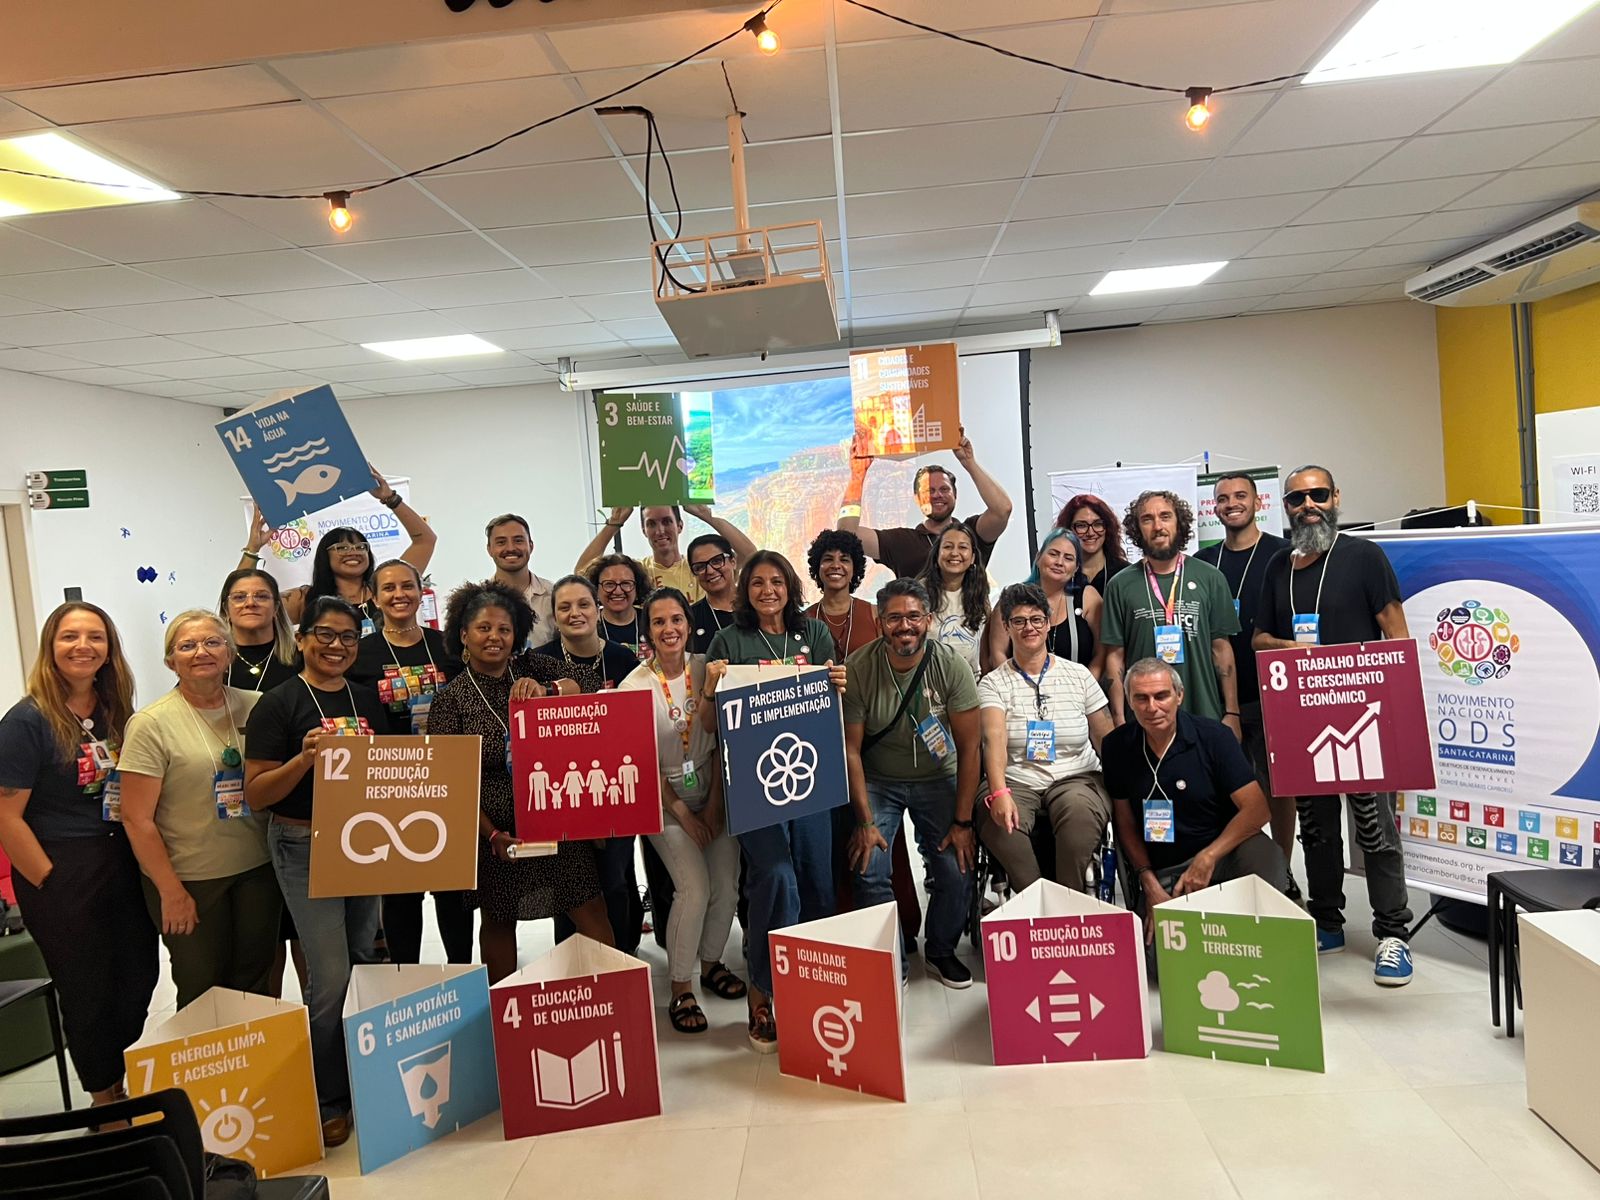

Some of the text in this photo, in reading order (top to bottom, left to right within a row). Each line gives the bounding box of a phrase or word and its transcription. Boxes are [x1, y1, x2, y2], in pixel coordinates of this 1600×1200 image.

[910, 354, 914, 363] E
[605, 402, 619, 427] 3
[626, 400, 660, 412] SAÚDE E
[255, 410, 290, 429] VIDA NA
[627, 416, 673, 426] BEM-ESTAR
[224, 426, 252, 453] 14
[263, 427, 287, 443] ÁGUA
[1570, 465, 1596, 475] WI-FI
[317, 513, 398, 530] MOVIMENTO ODS
[1295, 651, 1406, 672] TRABALHO DECENTE
[1269, 661, 1288, 691] 8
[1298, 671, 1385, 689] E CRESCIMENTO
[749, 680, 829, 708] PARCERIAS E MEIOS
[1300, 689, 1366, 707] ECONÔMICO
[1437, 694, 1515, 709] MOVIMENTO
[537, 702, 608, 720] ERRADICAÇÃO
[722, 698, 743, 731] 17
[751, 695, 831, 725] DE IMPLEMENTAÇÃO
[1438, 706, 1515, 721] NACIONAL
[514, 710, 526, 739] 1
[538, 722, 600, 738] DA POBREZA
[1438, 718, 1516, 747] ODS
[320, 748, 351, 780] 12
[368, 748, 433, 761] CONSUMO E
[1439, 747, 1515, 762] SANTA CATARINA
[367, 763, 429, 783] PRODUÇÃO
[366, 781, 448, 799] RESPONSÁVEIS
[1404, 863, 1487, 885] neariocamboriu@sc.m
[1030, 925, 1103, 943] REDUÇÃO DAS
[1158, 920, 1187, 951] 15
[1201, 923, 1227, 937] VIDA
[988, 931, 1017, 962] 10
[1032, 943, 1115, 959] DESIGUALDADES
[1202, 941, 1262, 958] TERRESTRE
[775, 944, 790, 975] 5
[797, 948, 847, 969] IGUALDADE
[799, 966, 847, 986] DE GÊNERO
[532, 985, 592, 1008] EDUCAÇÃO
[385, 990, 459, 1028] ÁGUA POTÁVEL
[503, 998, 521, 1029] 4
[533, 1002, 614, 1026] DE QUALIDADE
[387, 1007, 461, 1047] E SANEAMENTO
[171, 1031, 265, 1066] ENERGIA LIMPA
[357, 1022, 376, 1056] 6
[137, 1058, 155, 1094] 7
[173, 1055, 249, 1085] E ACESSÍVEL
